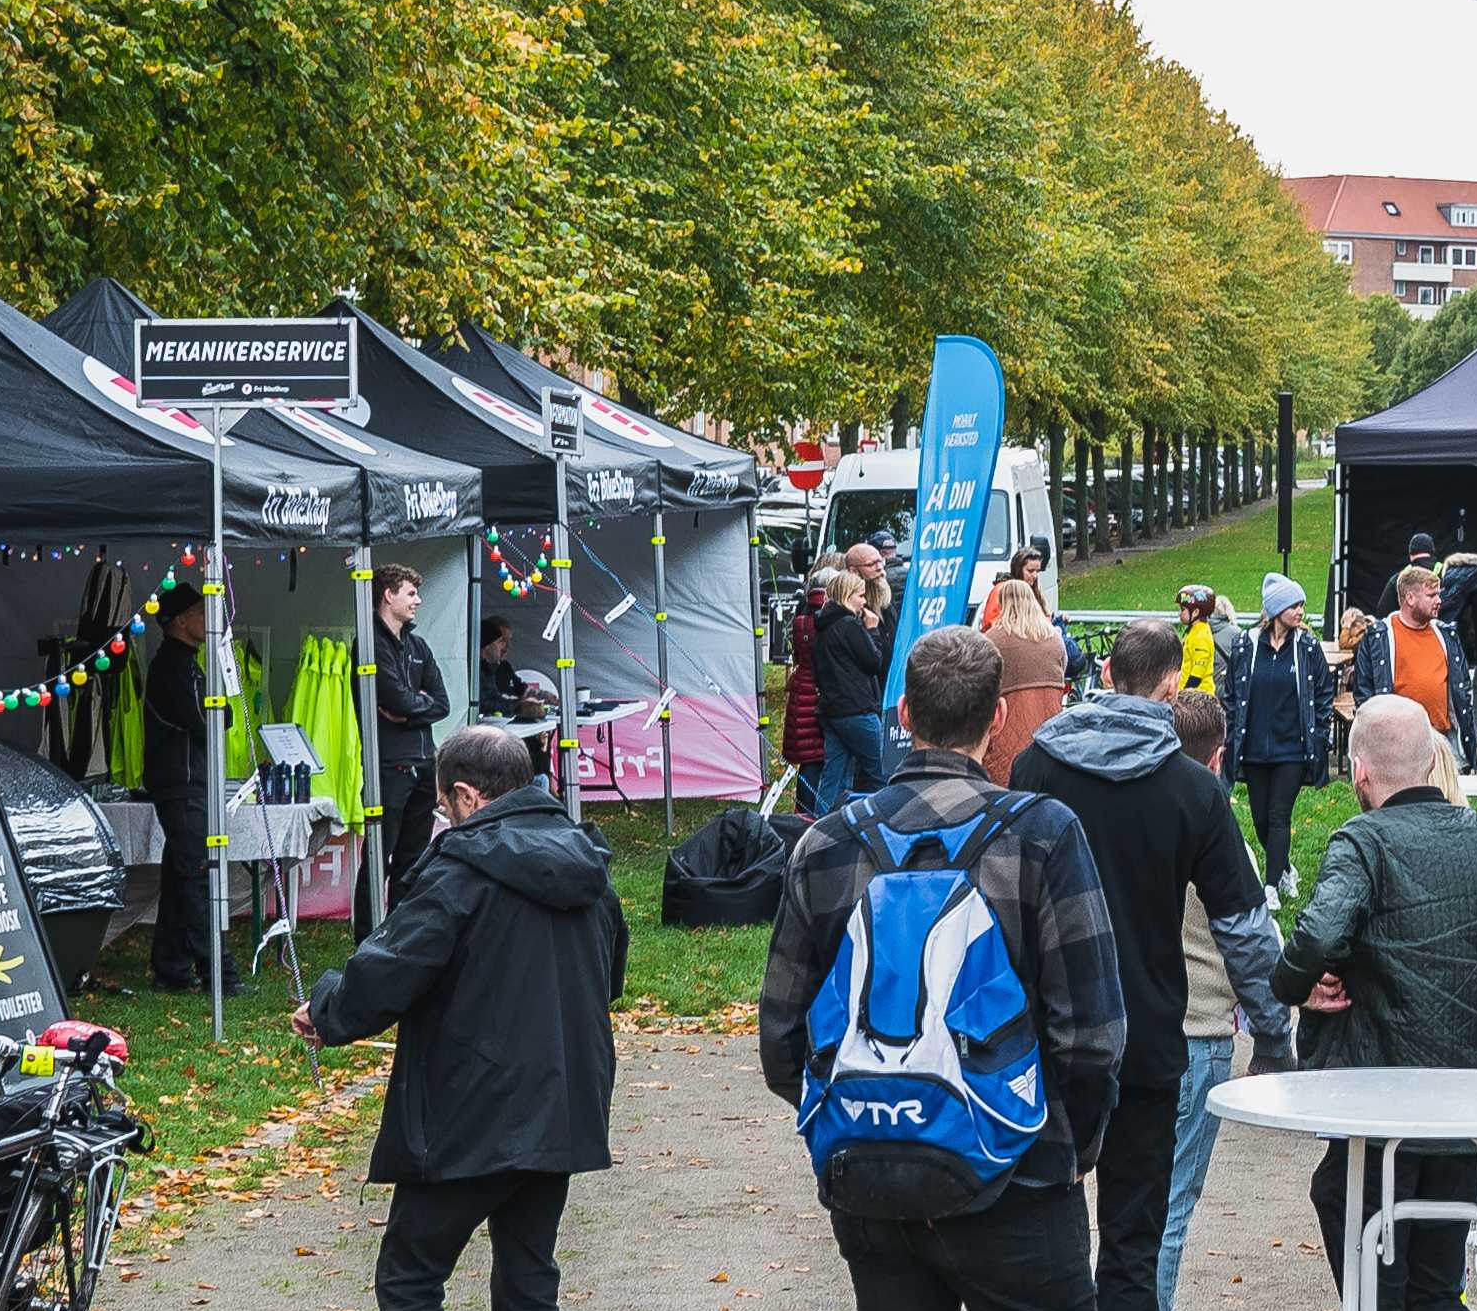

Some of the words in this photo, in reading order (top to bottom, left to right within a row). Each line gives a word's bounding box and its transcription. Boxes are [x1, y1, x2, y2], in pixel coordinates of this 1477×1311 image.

[145, 341, 347, 362] MEKANIKERSERVICE
[404, 484, 421, 521] Fri
[418, 481, 458, 519] BikeShop
[587, 472, 600, 503] Fri
[599, 468, 635, 506] BikeShop
[948, 480, 976, 511] DIN
[262, 486, 285, 525] Fri
[282, 486, 331, 534] BikeShop
[919, 519, 965, 550] CYKEL
[918, 557, 963, 588] SET
[867, 1099, 927, 1126] TYR
